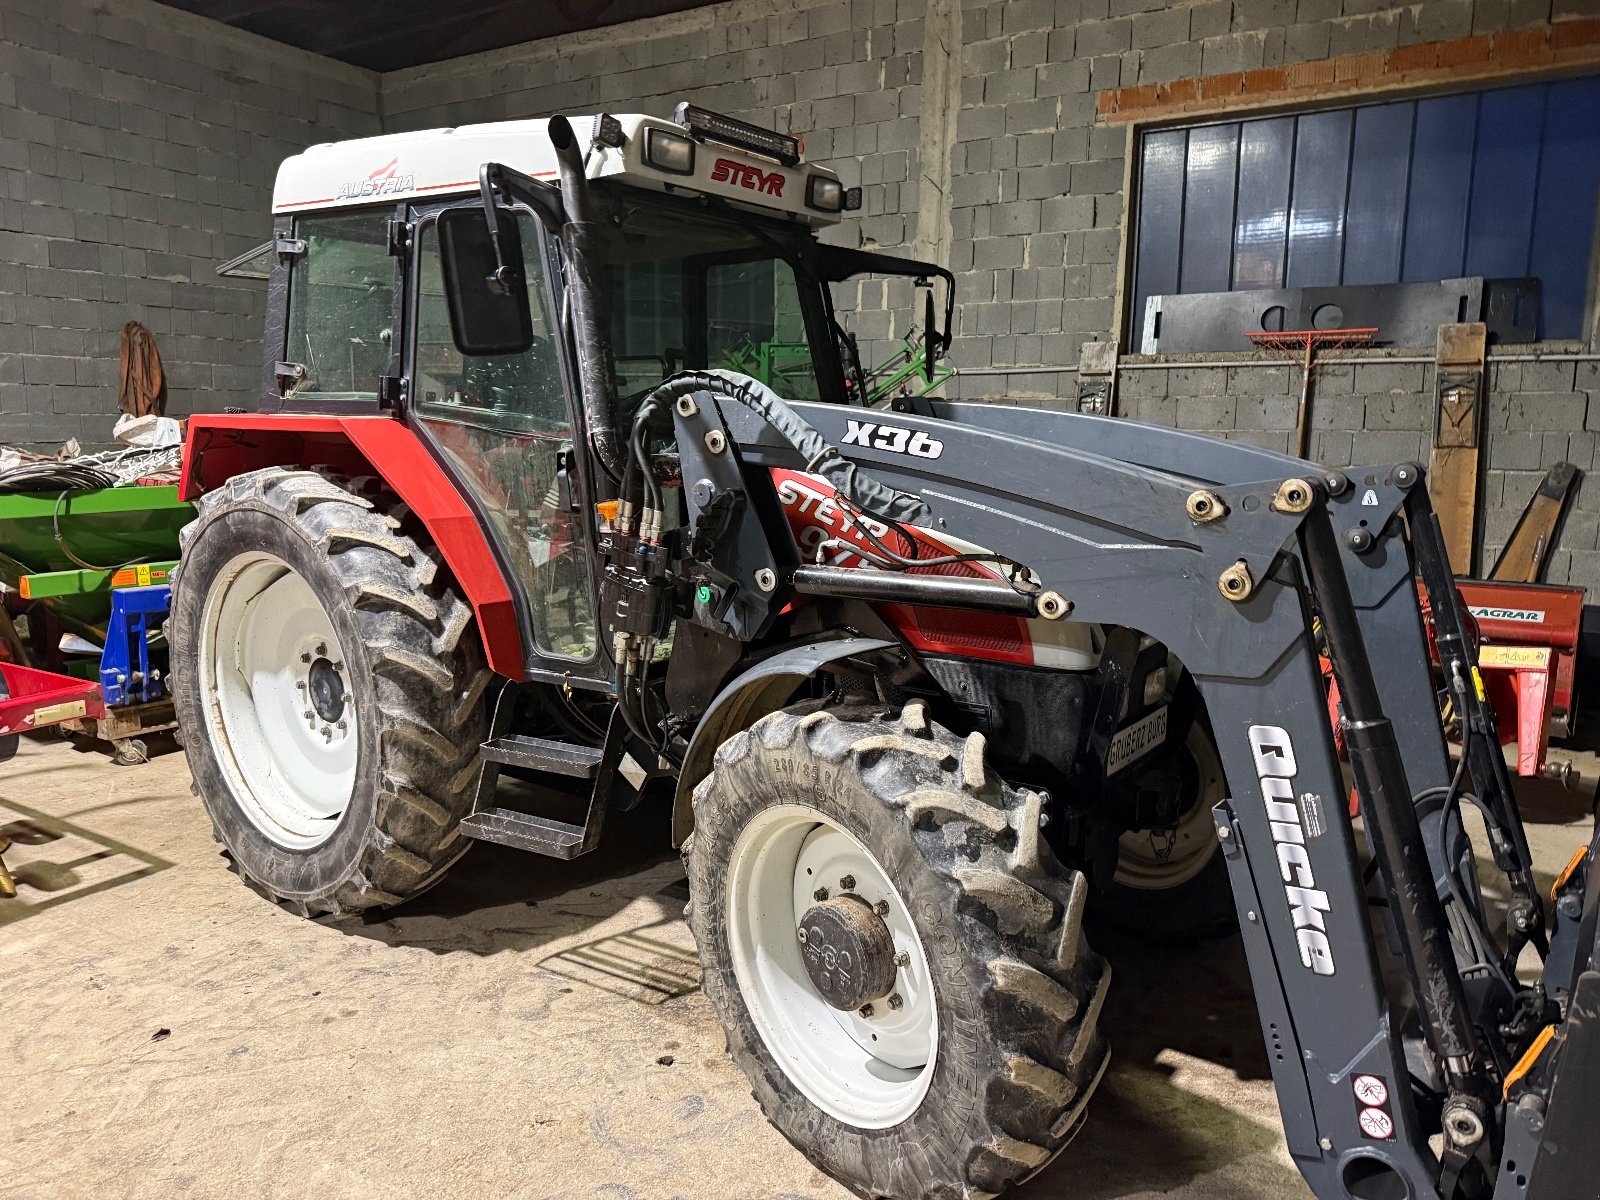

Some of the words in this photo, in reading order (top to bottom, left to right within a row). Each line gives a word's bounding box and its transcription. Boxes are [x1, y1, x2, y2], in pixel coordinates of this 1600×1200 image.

[336, 174, 415, 200] AUSTRIA
[710, 158, 786, 197] STEYR
[841, 420, 943, 459] X36
[1248, 724, 1336, 976] Quicke
